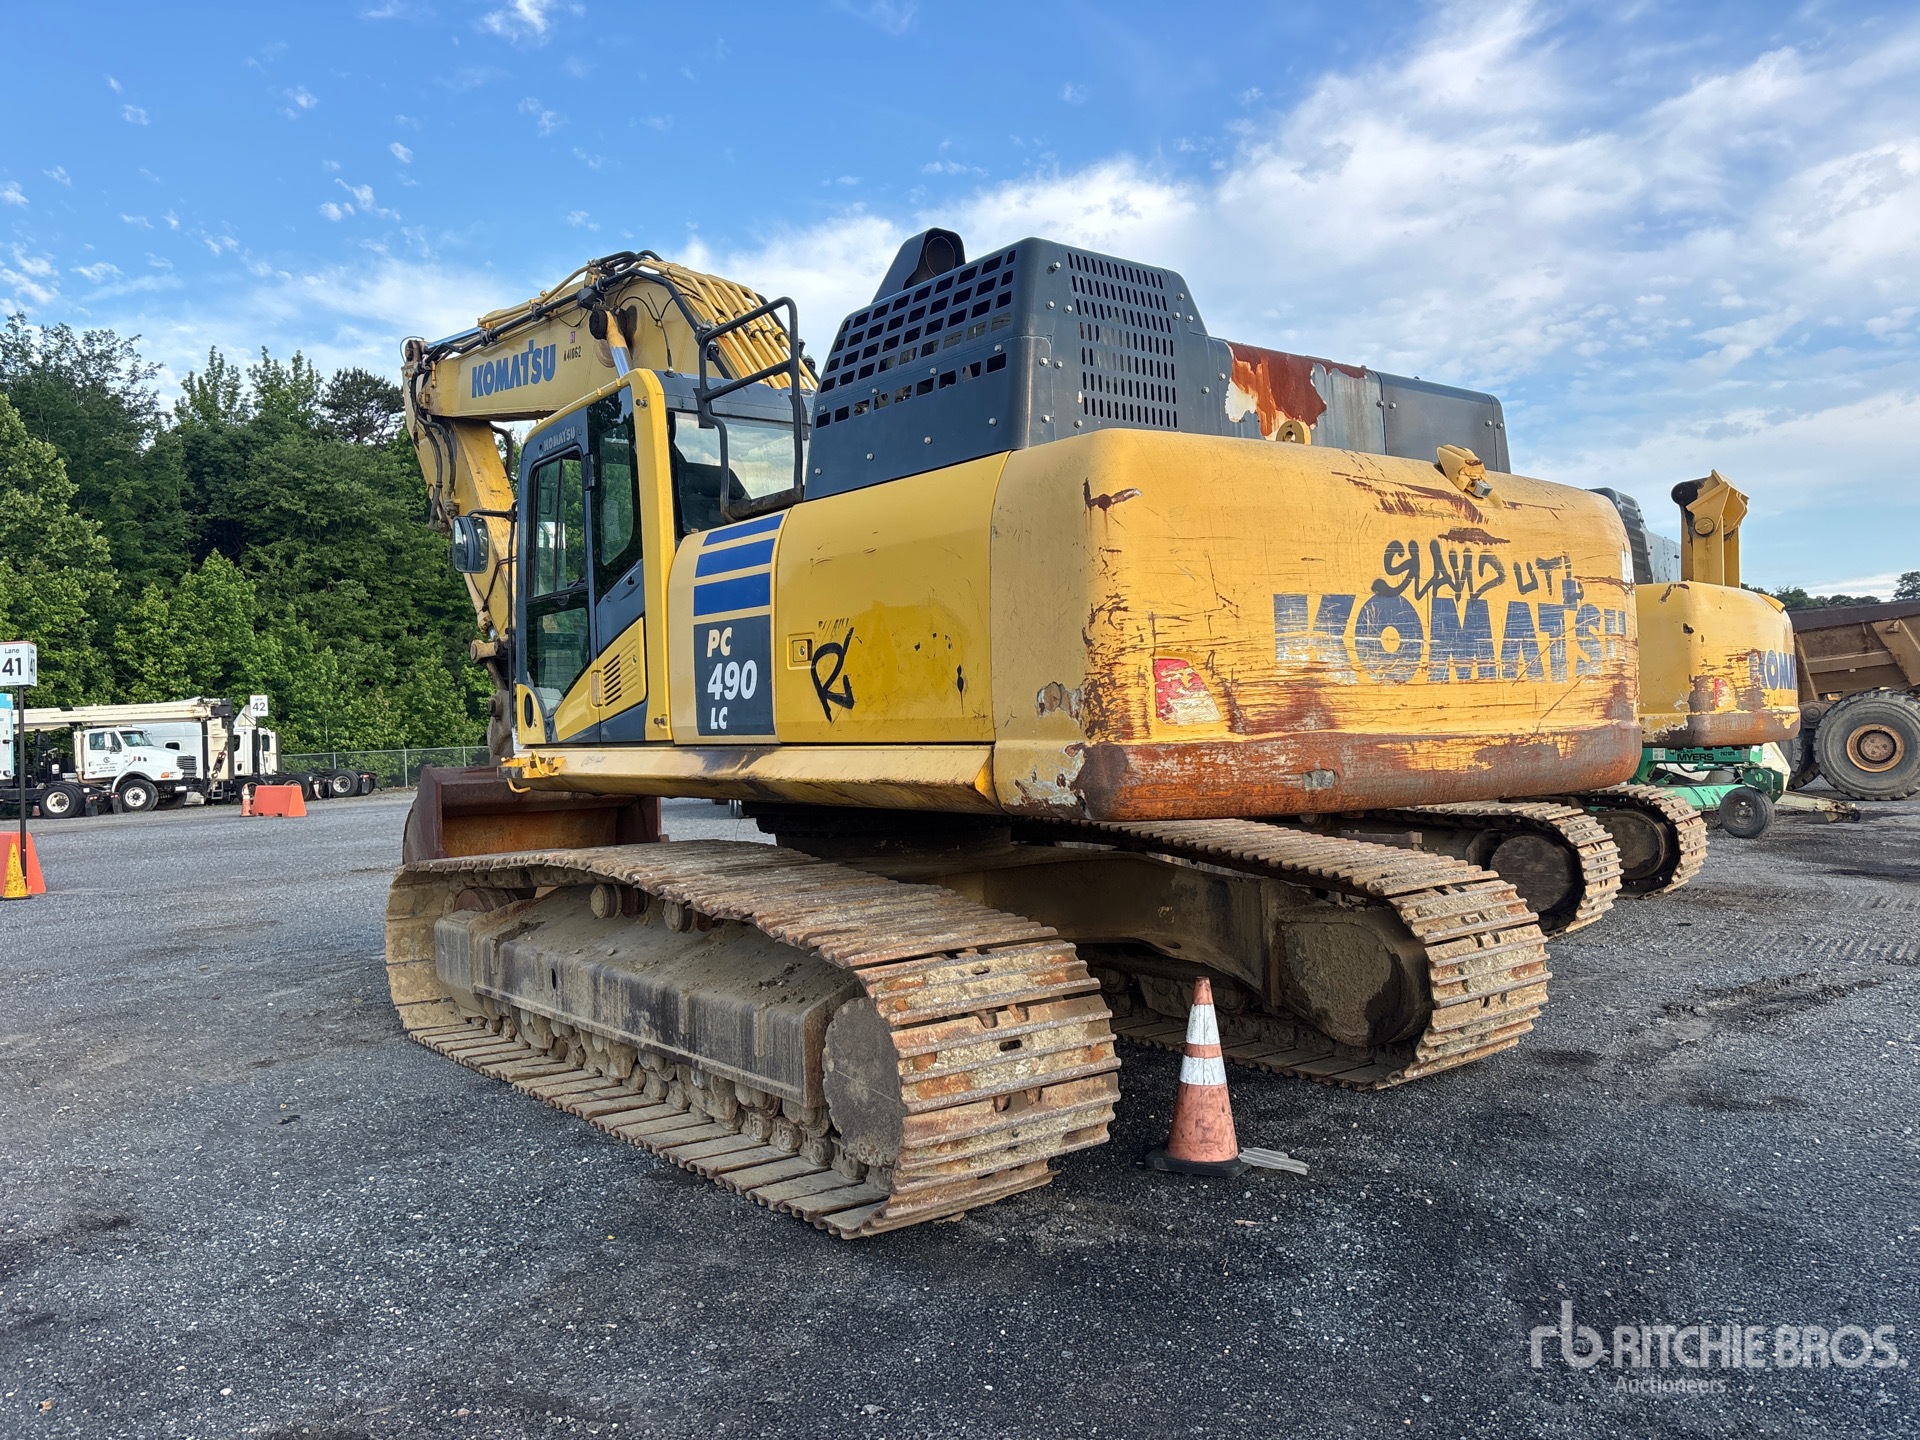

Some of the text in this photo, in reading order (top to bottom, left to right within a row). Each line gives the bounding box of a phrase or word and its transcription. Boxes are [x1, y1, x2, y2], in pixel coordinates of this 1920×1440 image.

[472, 339, 556, 398] KOMATSU
[543, 427, 575, 452] KOMATSU
[707, 627, 732, 657] PC
[1273, 578, 1626, 684] KOMATSU
[2, 657, 22, 676] 41
[707, 660, 758, 700] 490
[252, 702, 266, 711] 42
[710, 706, 728, 730] LC
